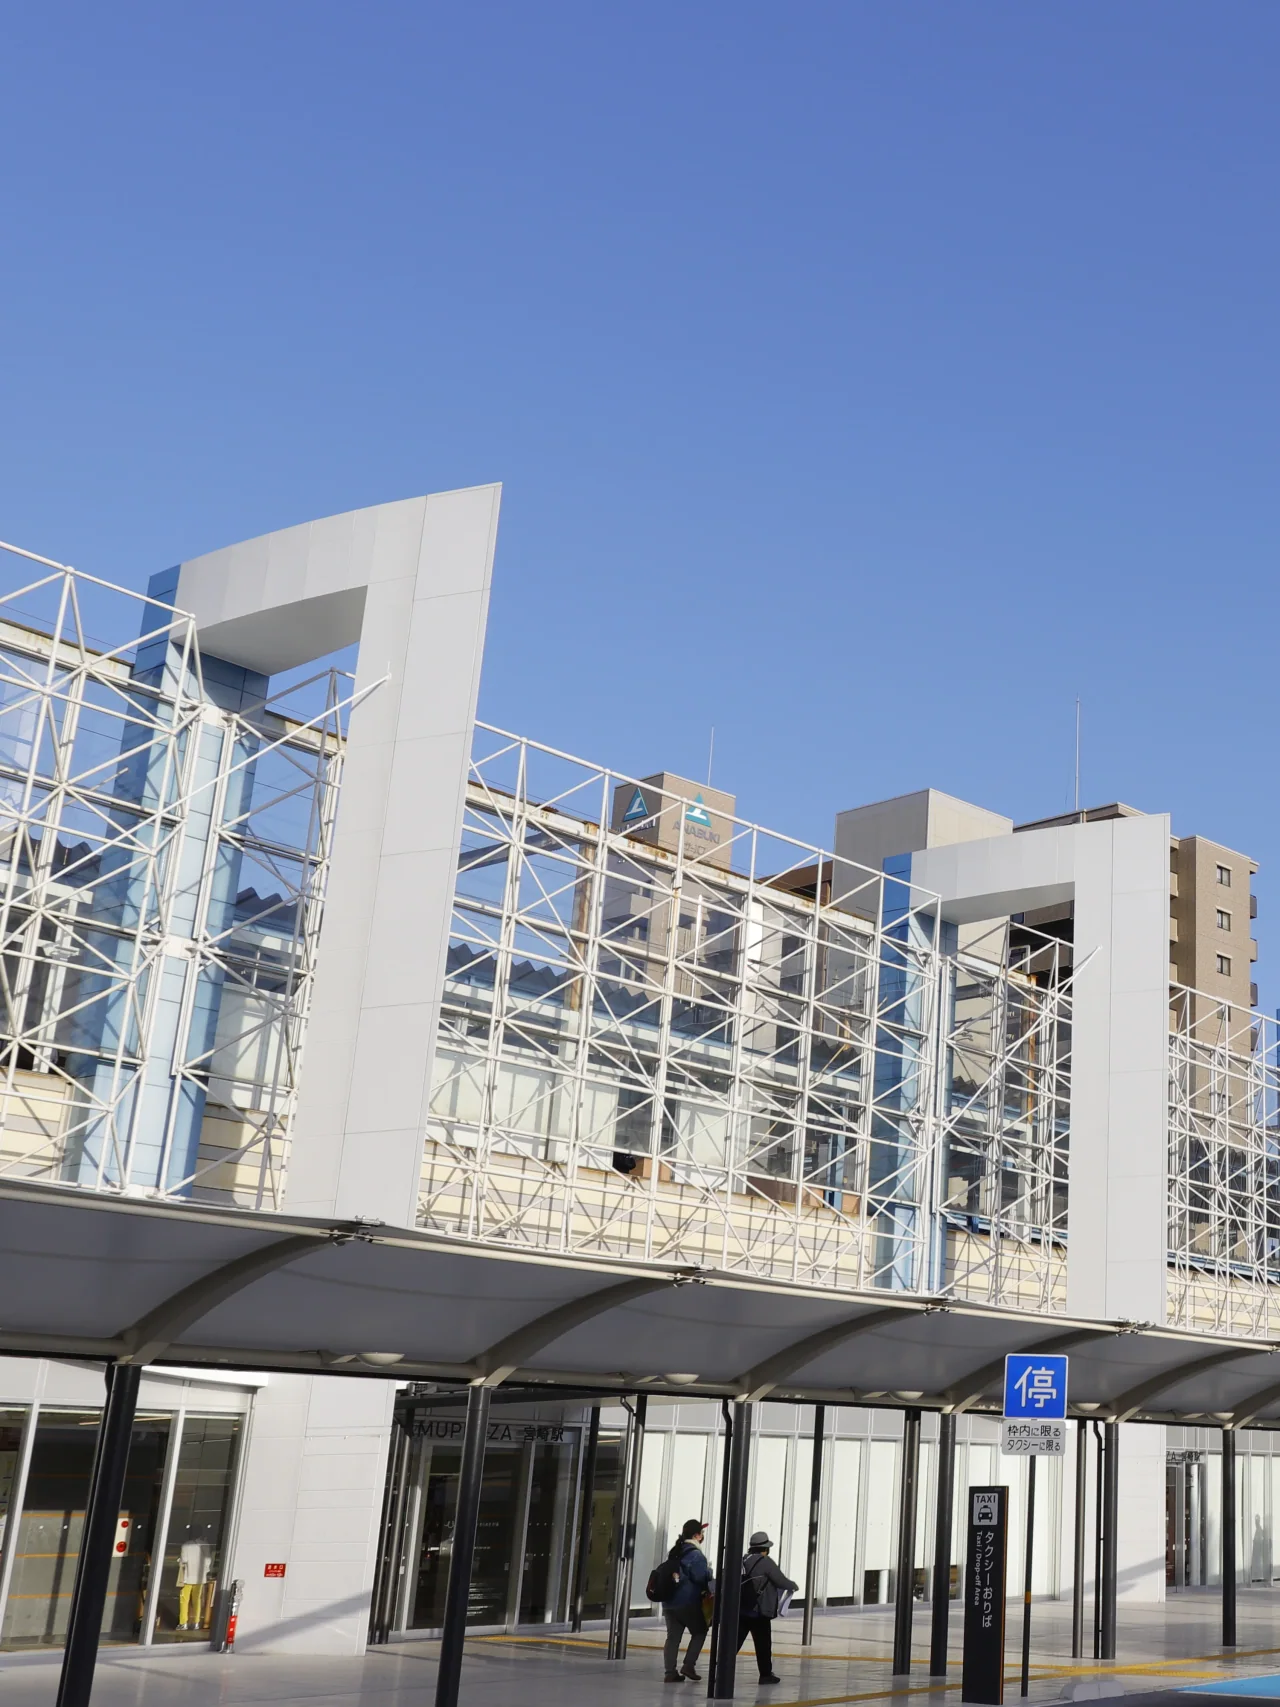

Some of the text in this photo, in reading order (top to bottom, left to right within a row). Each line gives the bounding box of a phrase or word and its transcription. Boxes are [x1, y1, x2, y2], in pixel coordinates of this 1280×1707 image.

[1014, 1366, 1057, 1408] 停
[412, 1421, 563, 1441] MUPZA 宮崎駅
[1007, 1424, 1061, 1437] 枠内に限る
[1007, 1439, 1061, 1451] タクシーに限る
[975, 1495, 996, 1503] TAXI
[974, 1553, 983, 1586] Drop-off
[982, 1531, 995, 1628] タクシーおりば
